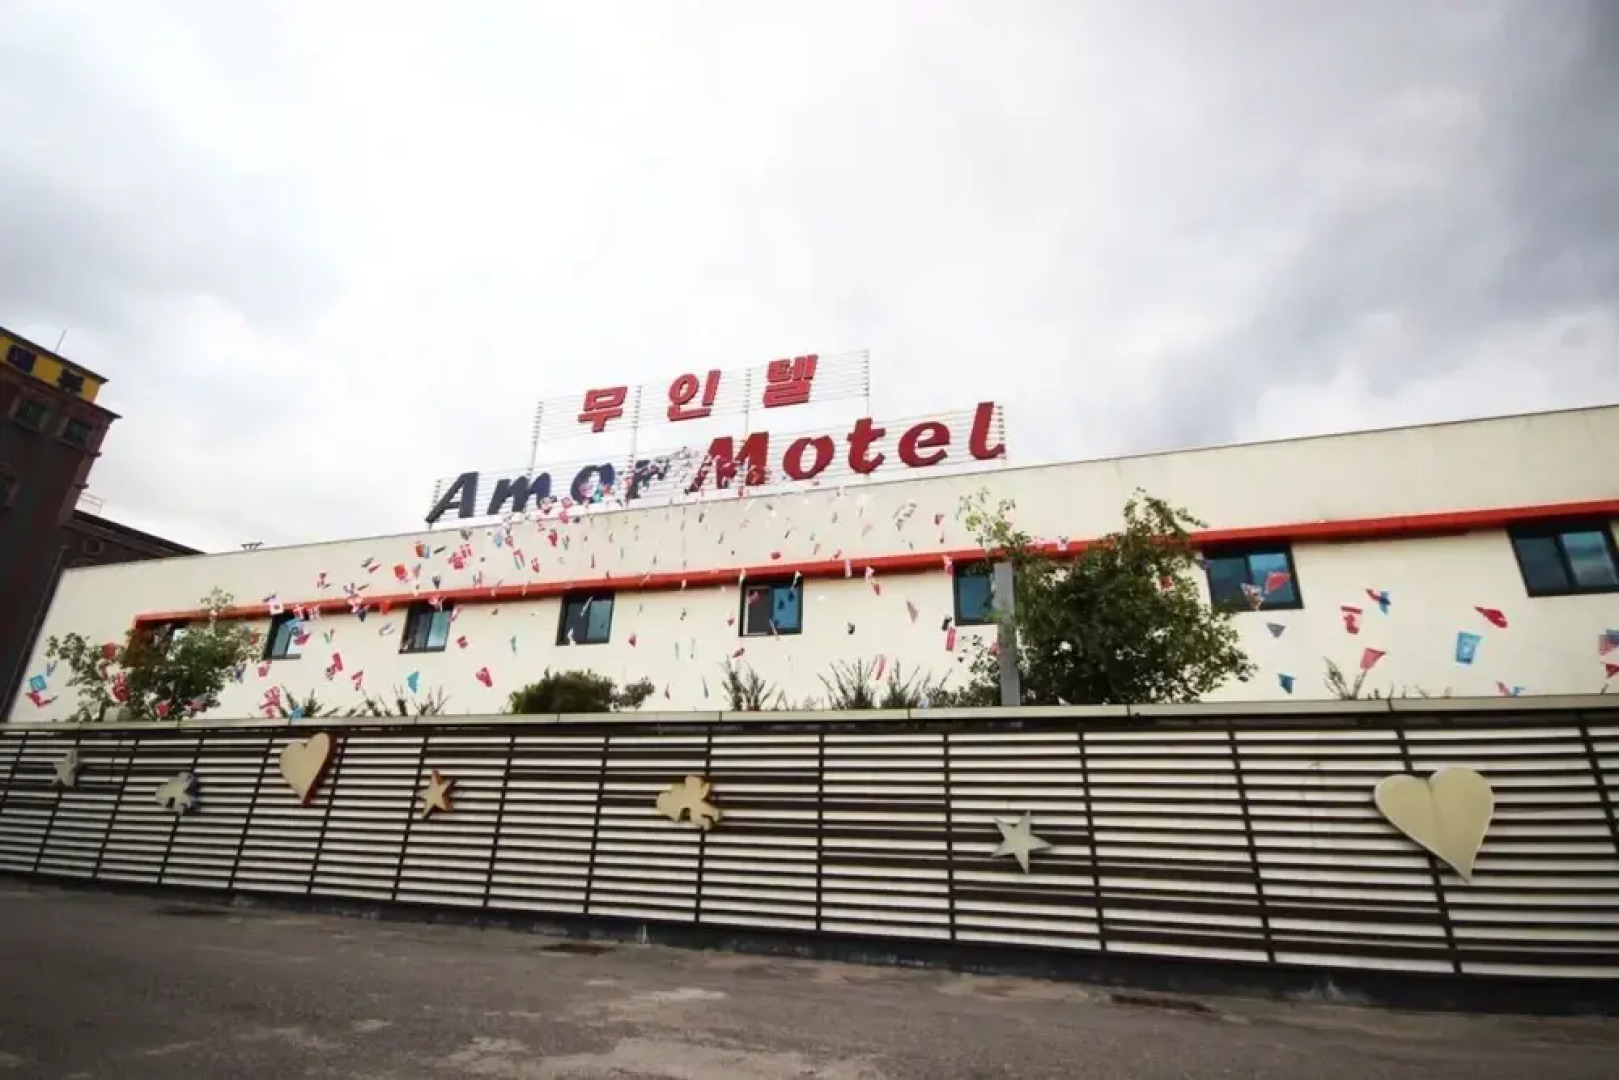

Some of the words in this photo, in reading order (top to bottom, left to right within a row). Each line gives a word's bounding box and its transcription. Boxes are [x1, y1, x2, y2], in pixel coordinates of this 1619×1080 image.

[578, 354, 818, 433] 무인텔
[424, 458, 671, 523] Amor
[684, 401, 1005, 494] Motel
